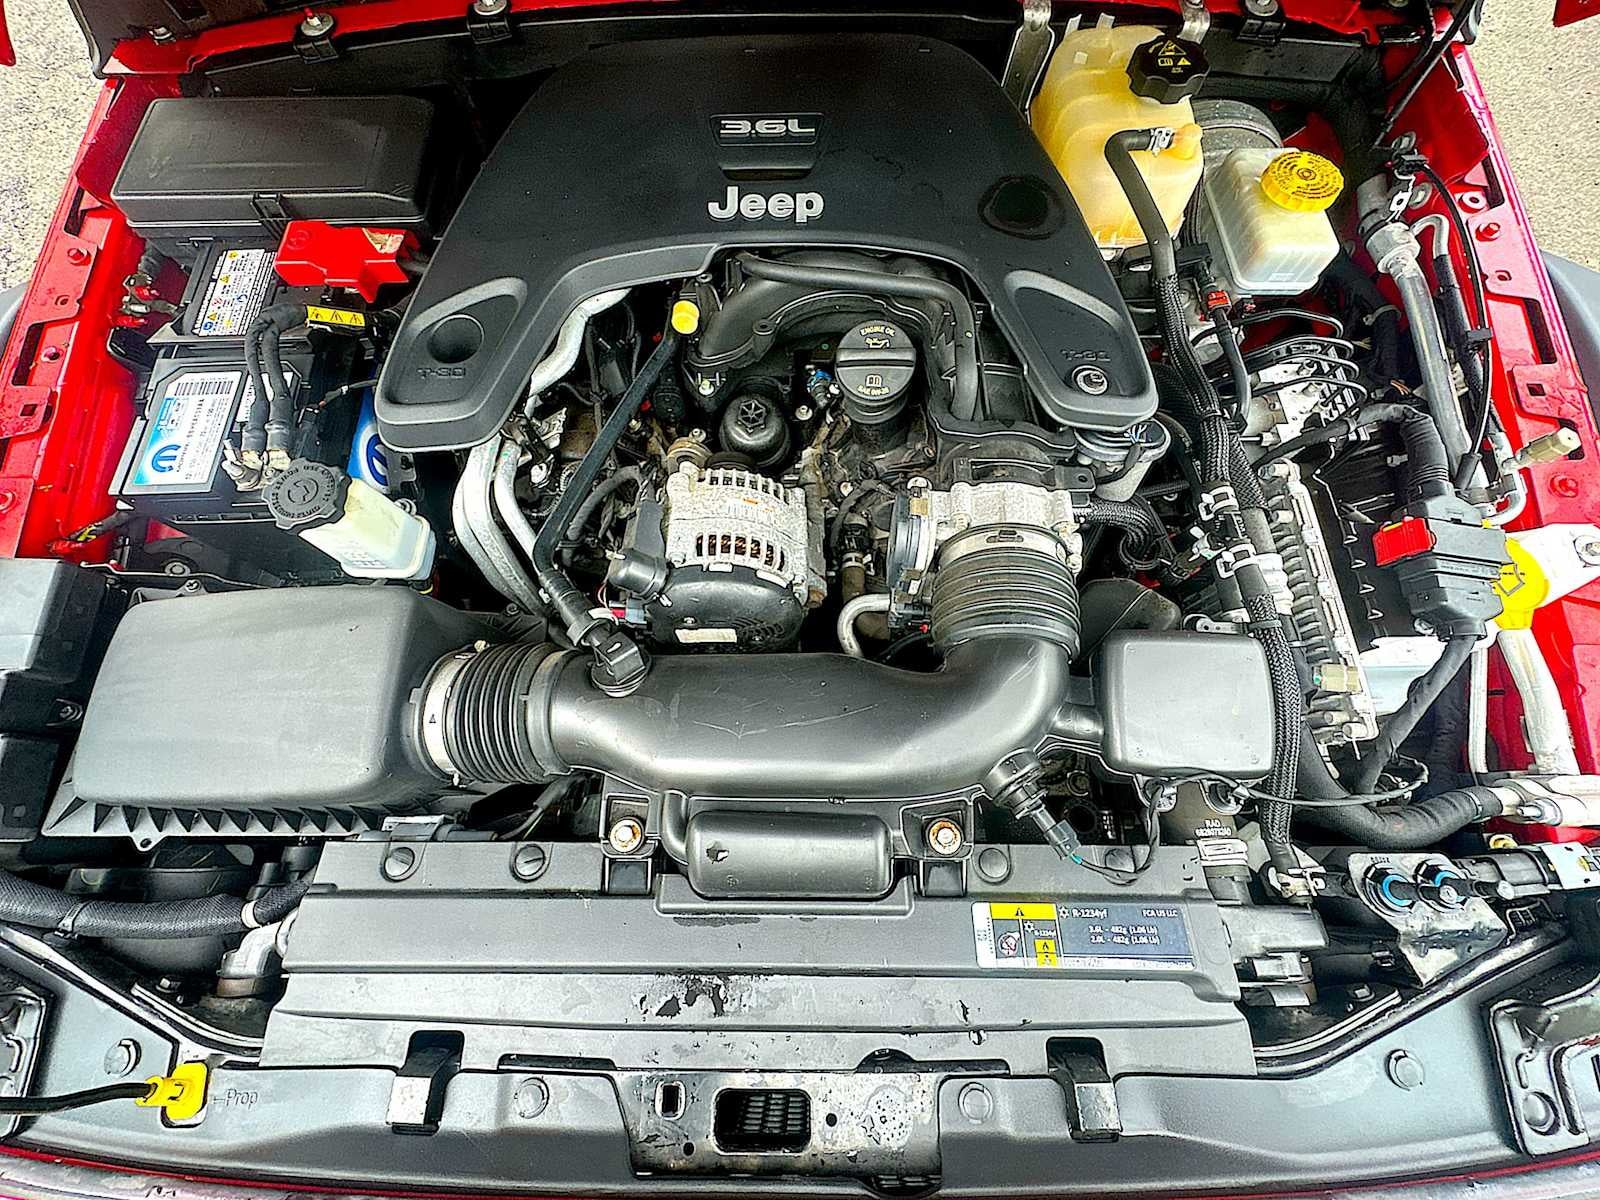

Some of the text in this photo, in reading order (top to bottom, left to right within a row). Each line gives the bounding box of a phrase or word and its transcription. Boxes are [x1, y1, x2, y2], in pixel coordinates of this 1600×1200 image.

[720, 119, 815, 137] 3.6L
[707, 185, 824, 225] Jeep
[860, 326, 896, 337] ENGINE OIL
[1205, 819, 1221, 828] RAD
[1072, 908, 1107, 919] R-1234yf
[1142, 909, 1178, 917] FCA US LLC
[226, 1088, 258, 1110] Prop
